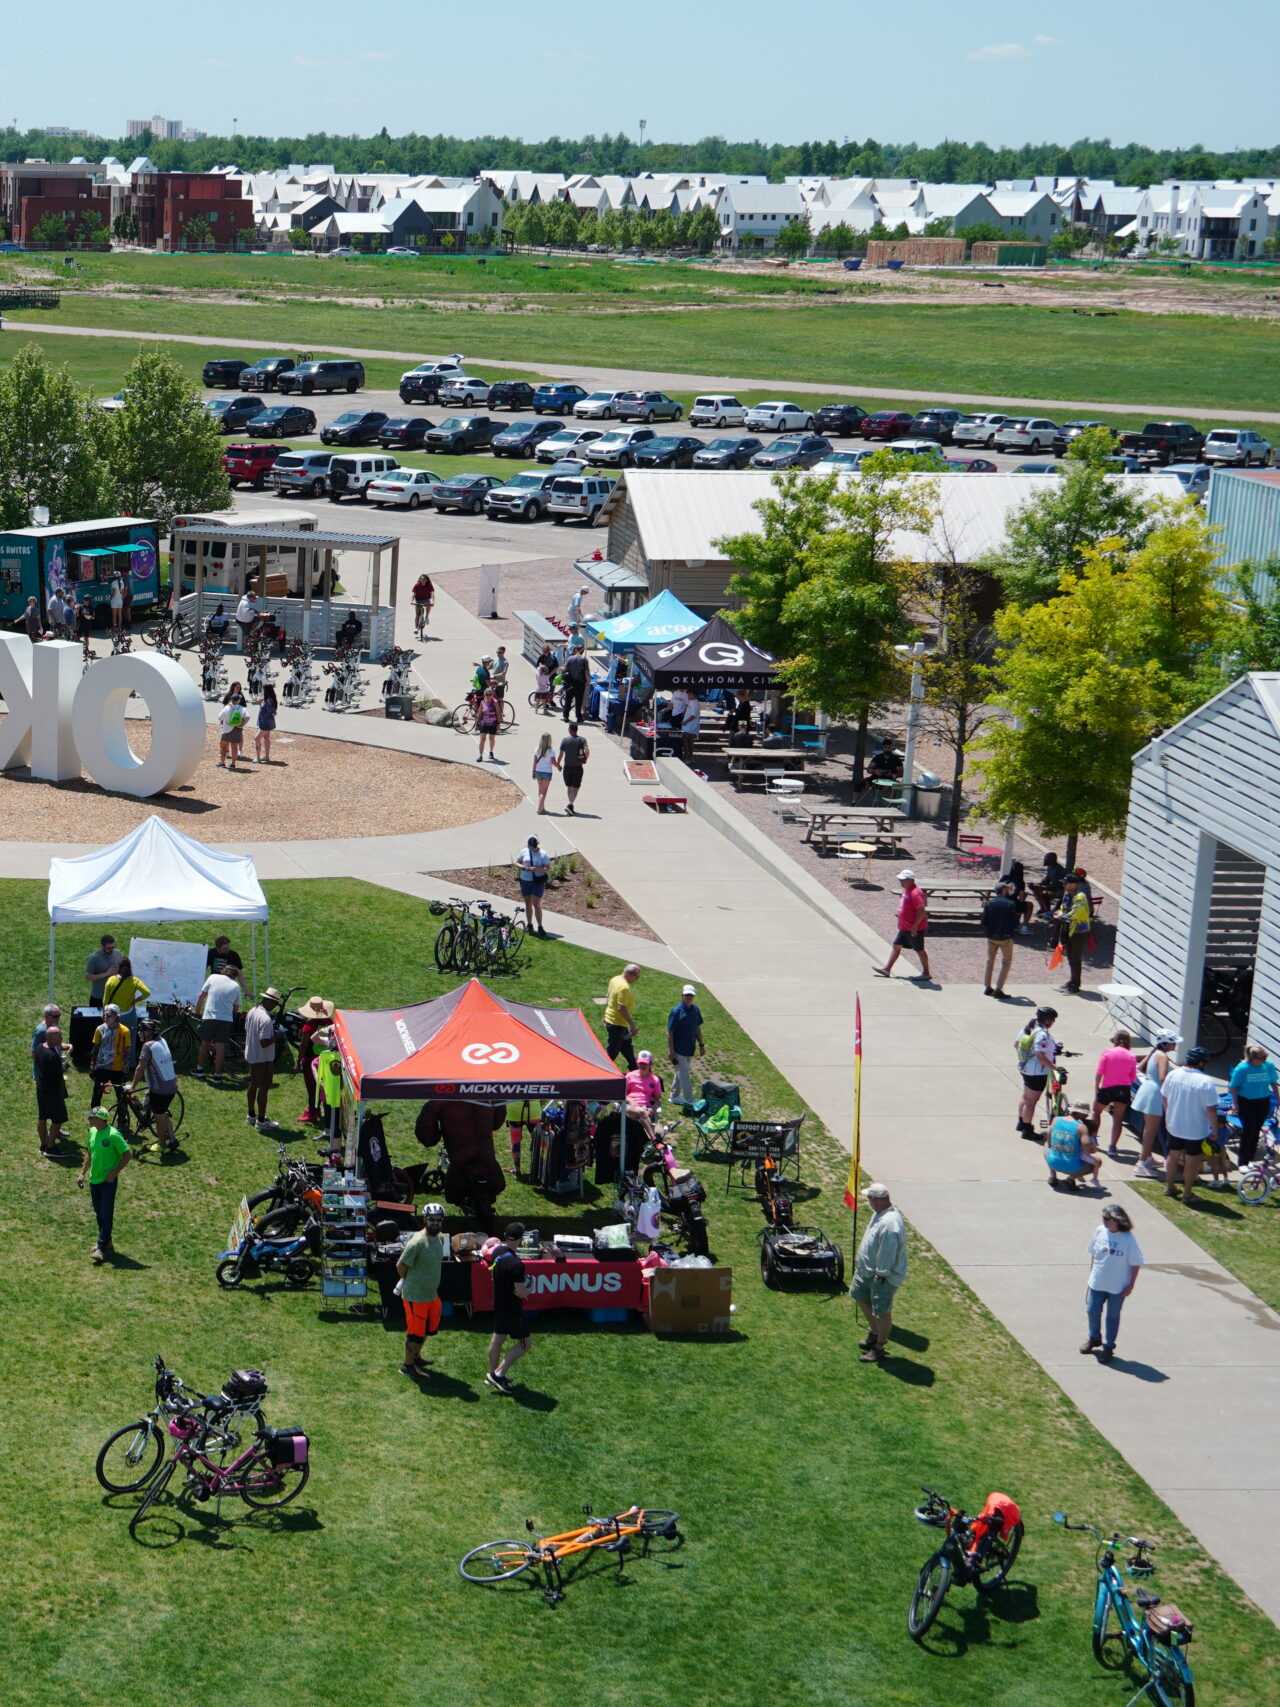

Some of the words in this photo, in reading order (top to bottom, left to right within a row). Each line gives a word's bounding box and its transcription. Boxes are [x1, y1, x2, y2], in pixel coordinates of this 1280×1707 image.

[672, 676, 744, 684] OKLAHOMA
[752, 676, 773, 684] CIT
[459, 1084, 560, 1095] MOKWHEEL
